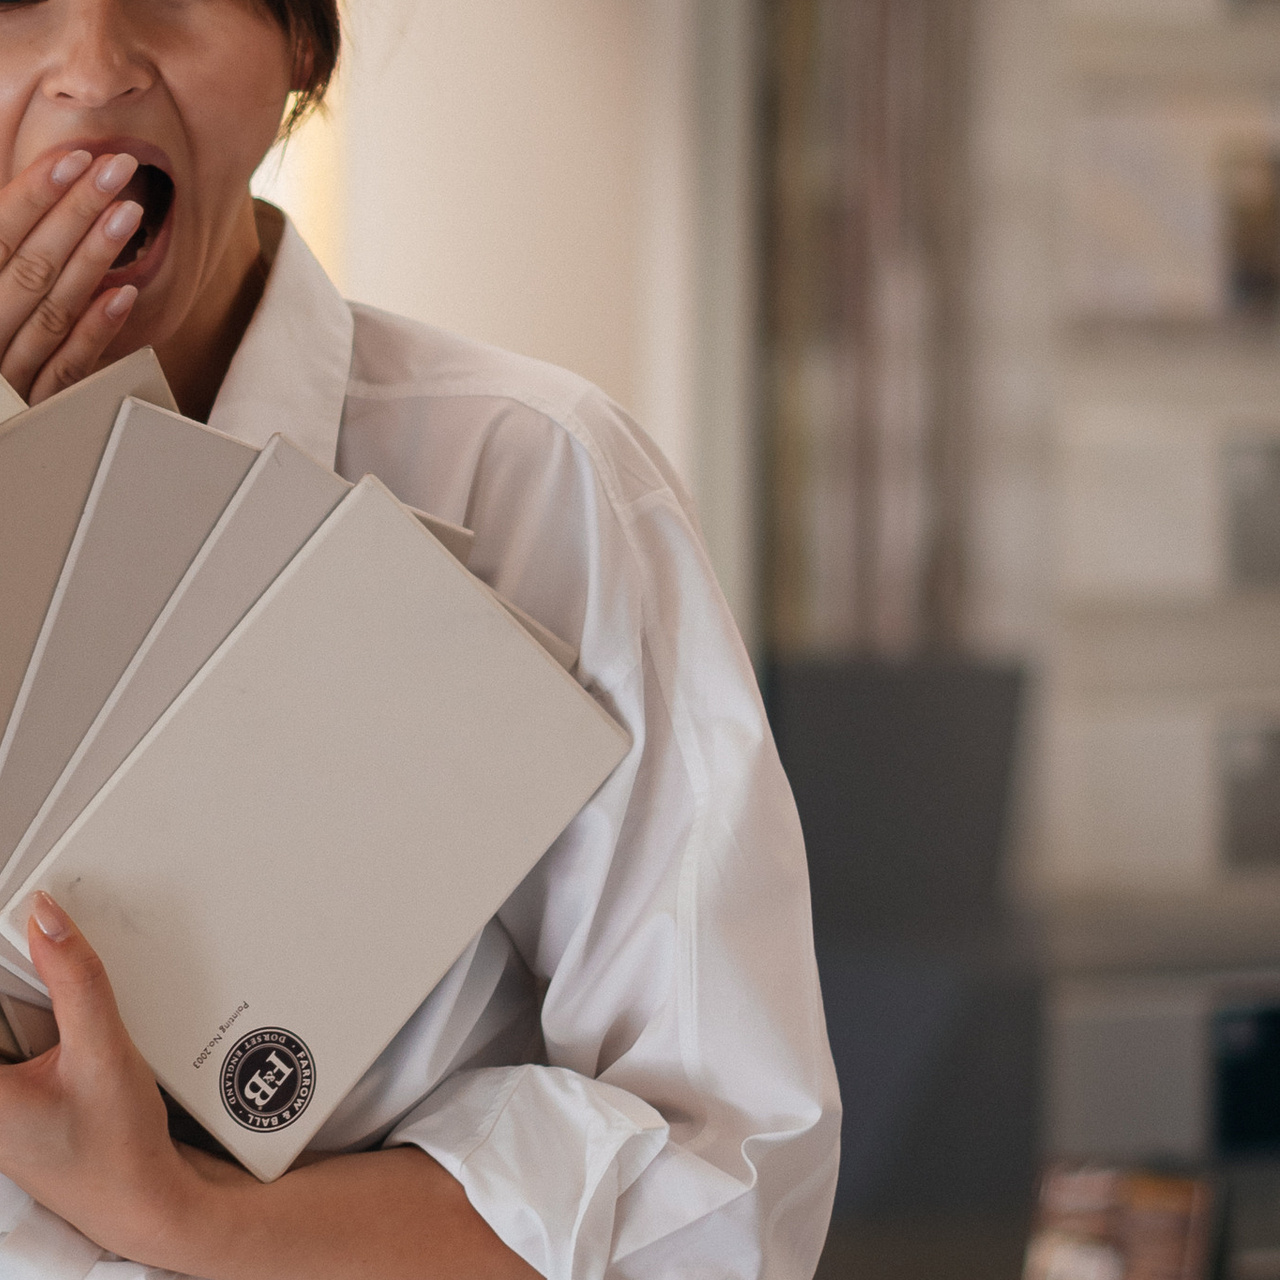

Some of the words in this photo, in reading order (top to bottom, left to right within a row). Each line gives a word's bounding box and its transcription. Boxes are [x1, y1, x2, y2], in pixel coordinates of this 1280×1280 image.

[218, 1000, 250, 1033] Pointing
[192, 1033, 223, 1069] No.2003
[244, 1033, 287, 1050] DORSET
[225, 1050, 243, 1105] ENGLAND
[244, 1050, 294, 1107] F&B
[293, 1051, 311, 1111] FARROW
[247, 1113, 279, 1127] BALL
[281, 1109, 292, 1120] &
